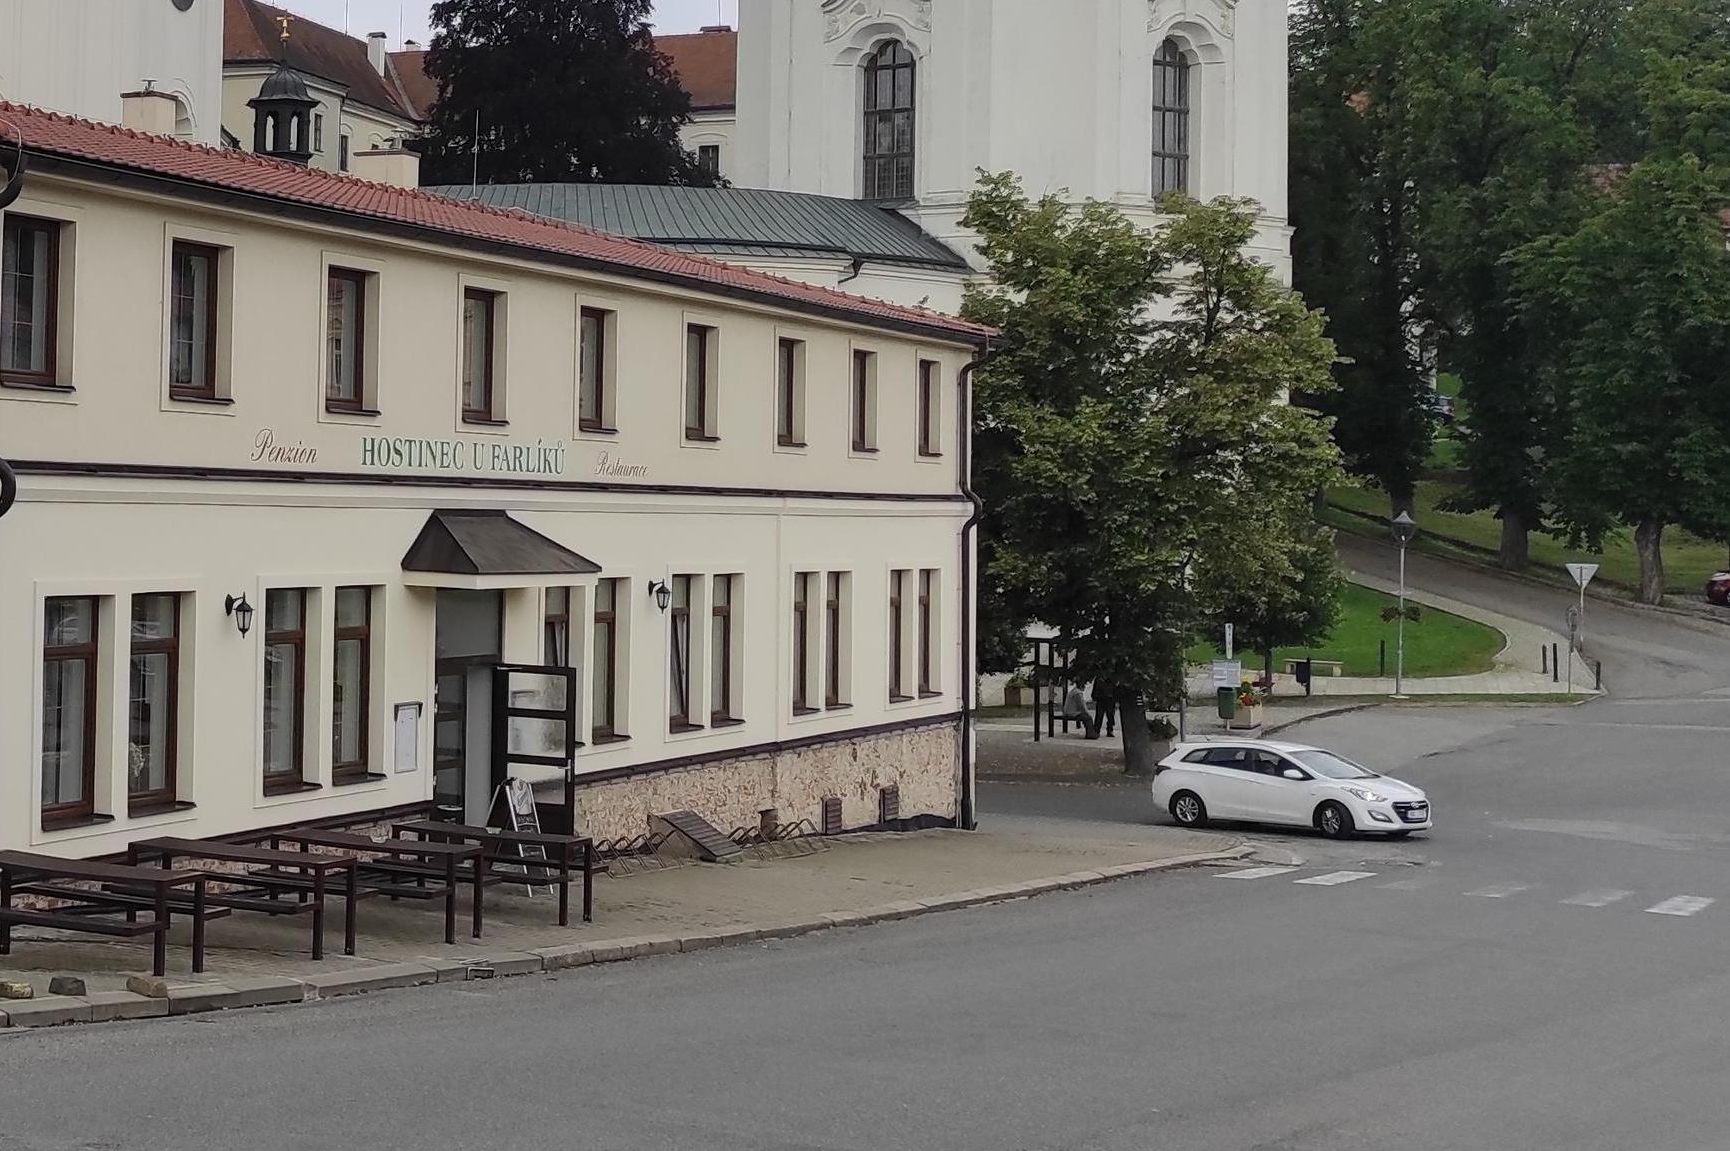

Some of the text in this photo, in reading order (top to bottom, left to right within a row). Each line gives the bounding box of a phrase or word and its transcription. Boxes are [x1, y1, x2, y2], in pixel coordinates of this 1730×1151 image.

[250, 427, 649, 478] Penzion HOSTINEC U FARLÍKŮ Restaurace
